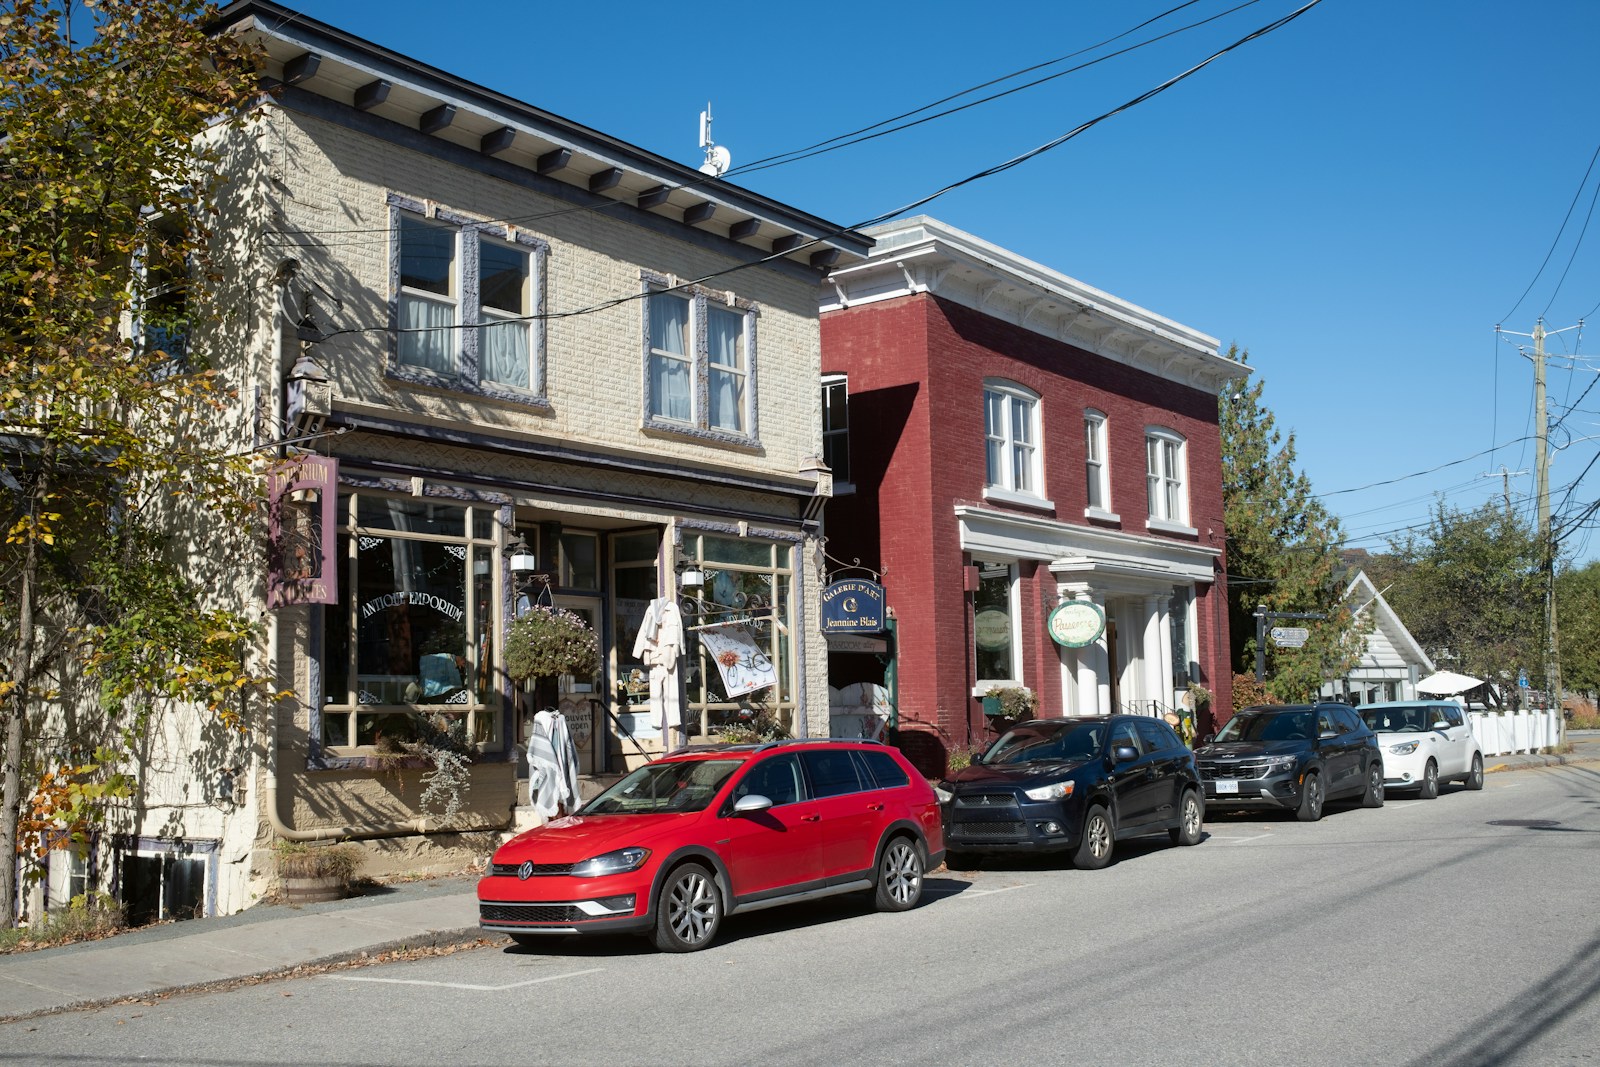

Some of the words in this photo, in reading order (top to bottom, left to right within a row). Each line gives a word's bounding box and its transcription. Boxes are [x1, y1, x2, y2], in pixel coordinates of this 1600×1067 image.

[823, 584, 856, 602] GALERIE
[858, 584, 880, 600] D'ART
[362, 591, 405, 619] ANTIQUE
[408, 591, 464, 622] EMPORIUM
[826, 617, 859, 629] Jeannine
[859, 616, 878, 627] Blais
[565, 712, 592, 721] ouvert
[570, 722, 589, 732] open
